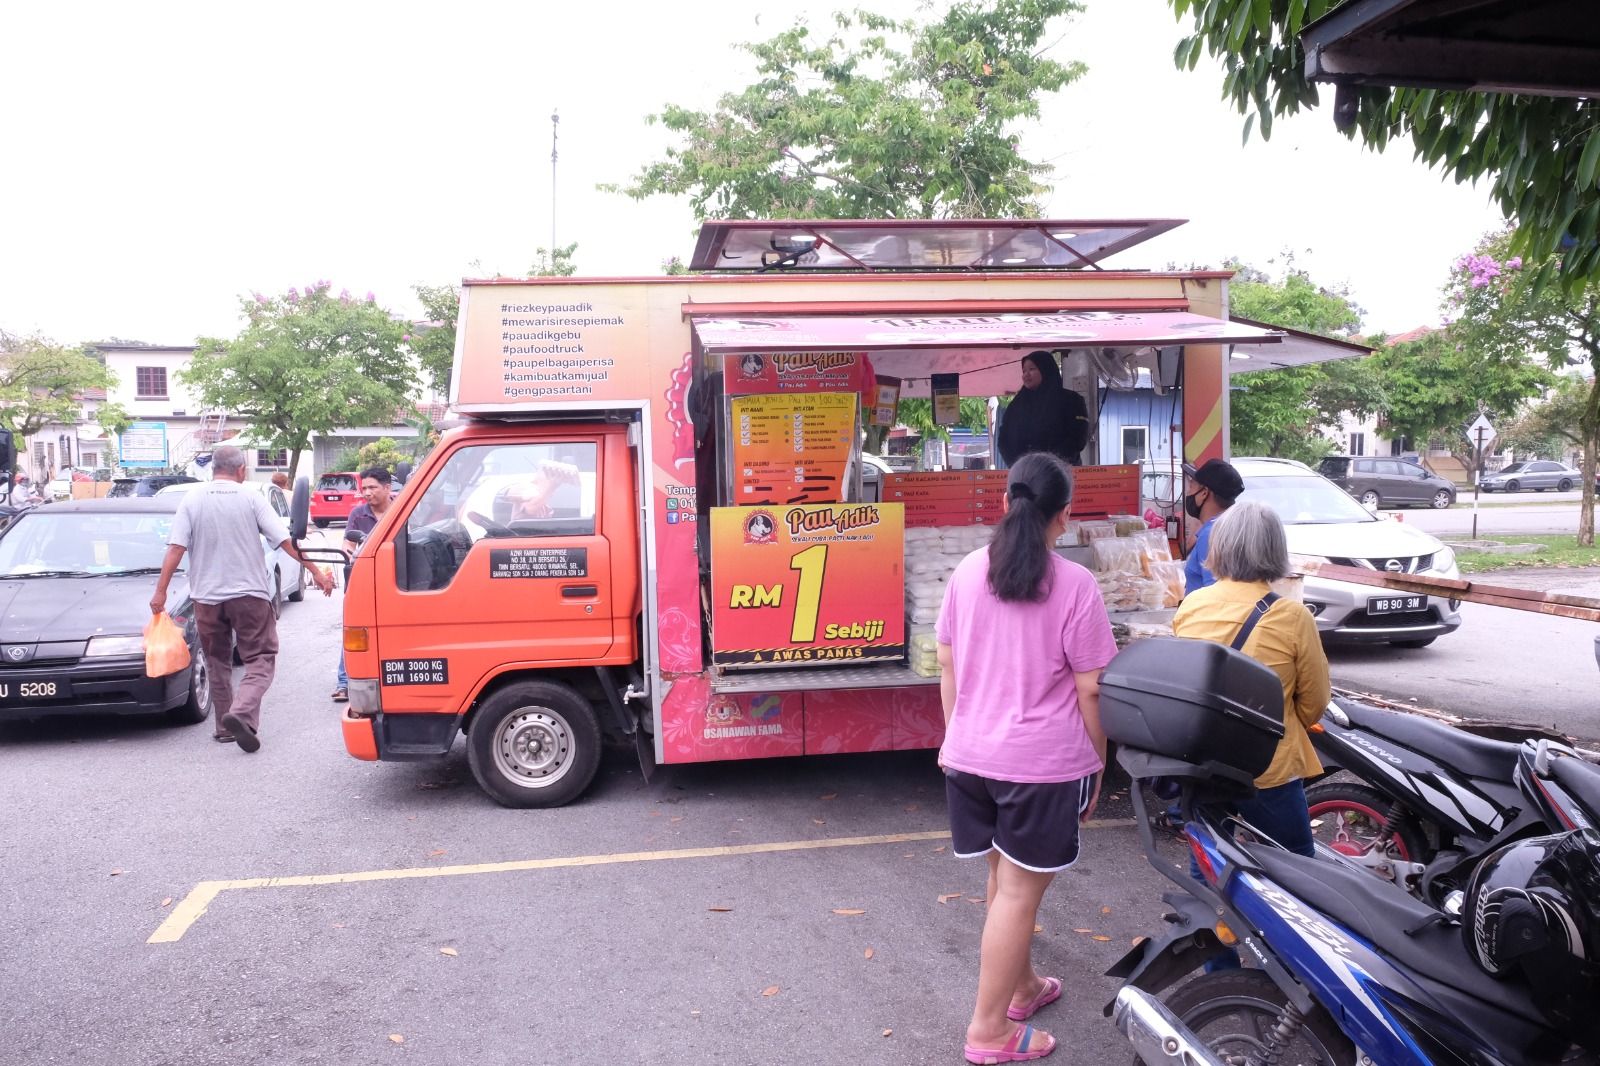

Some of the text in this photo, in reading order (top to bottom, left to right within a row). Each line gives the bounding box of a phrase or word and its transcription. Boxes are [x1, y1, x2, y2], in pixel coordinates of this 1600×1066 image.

[501, 303, 592, 314] #riezkeypauadik
[502, 316, 624, 327] #mewarisiresepiemak
[502, 330, 581, 342] #pauadikgebu
[503, 344, 584, 356] #paufoodtruck
[504, 358, 614, 369] #paupelbagaiperisa
[504, 371, 608, 382] #kamibuatkamijual
[504, 385, 592, 397] #gengpasartani
[682, 512, 698, 522] Pa
[786, 506, 880, 534] Pau Adik
[730, 544, 884, 644] RM 1 Sebiji
[1376, 598, 1420, 610] WB 90 3M
[773, 648, 862, 660] AWAS PANAS
[386, 660, 442, 672] BDM 3000 KG
[386, 672, 444, 684] BTM 1690 KG
[0, 682, 56, 698] U 5208
[758, 724, 782, 736] FAMA
